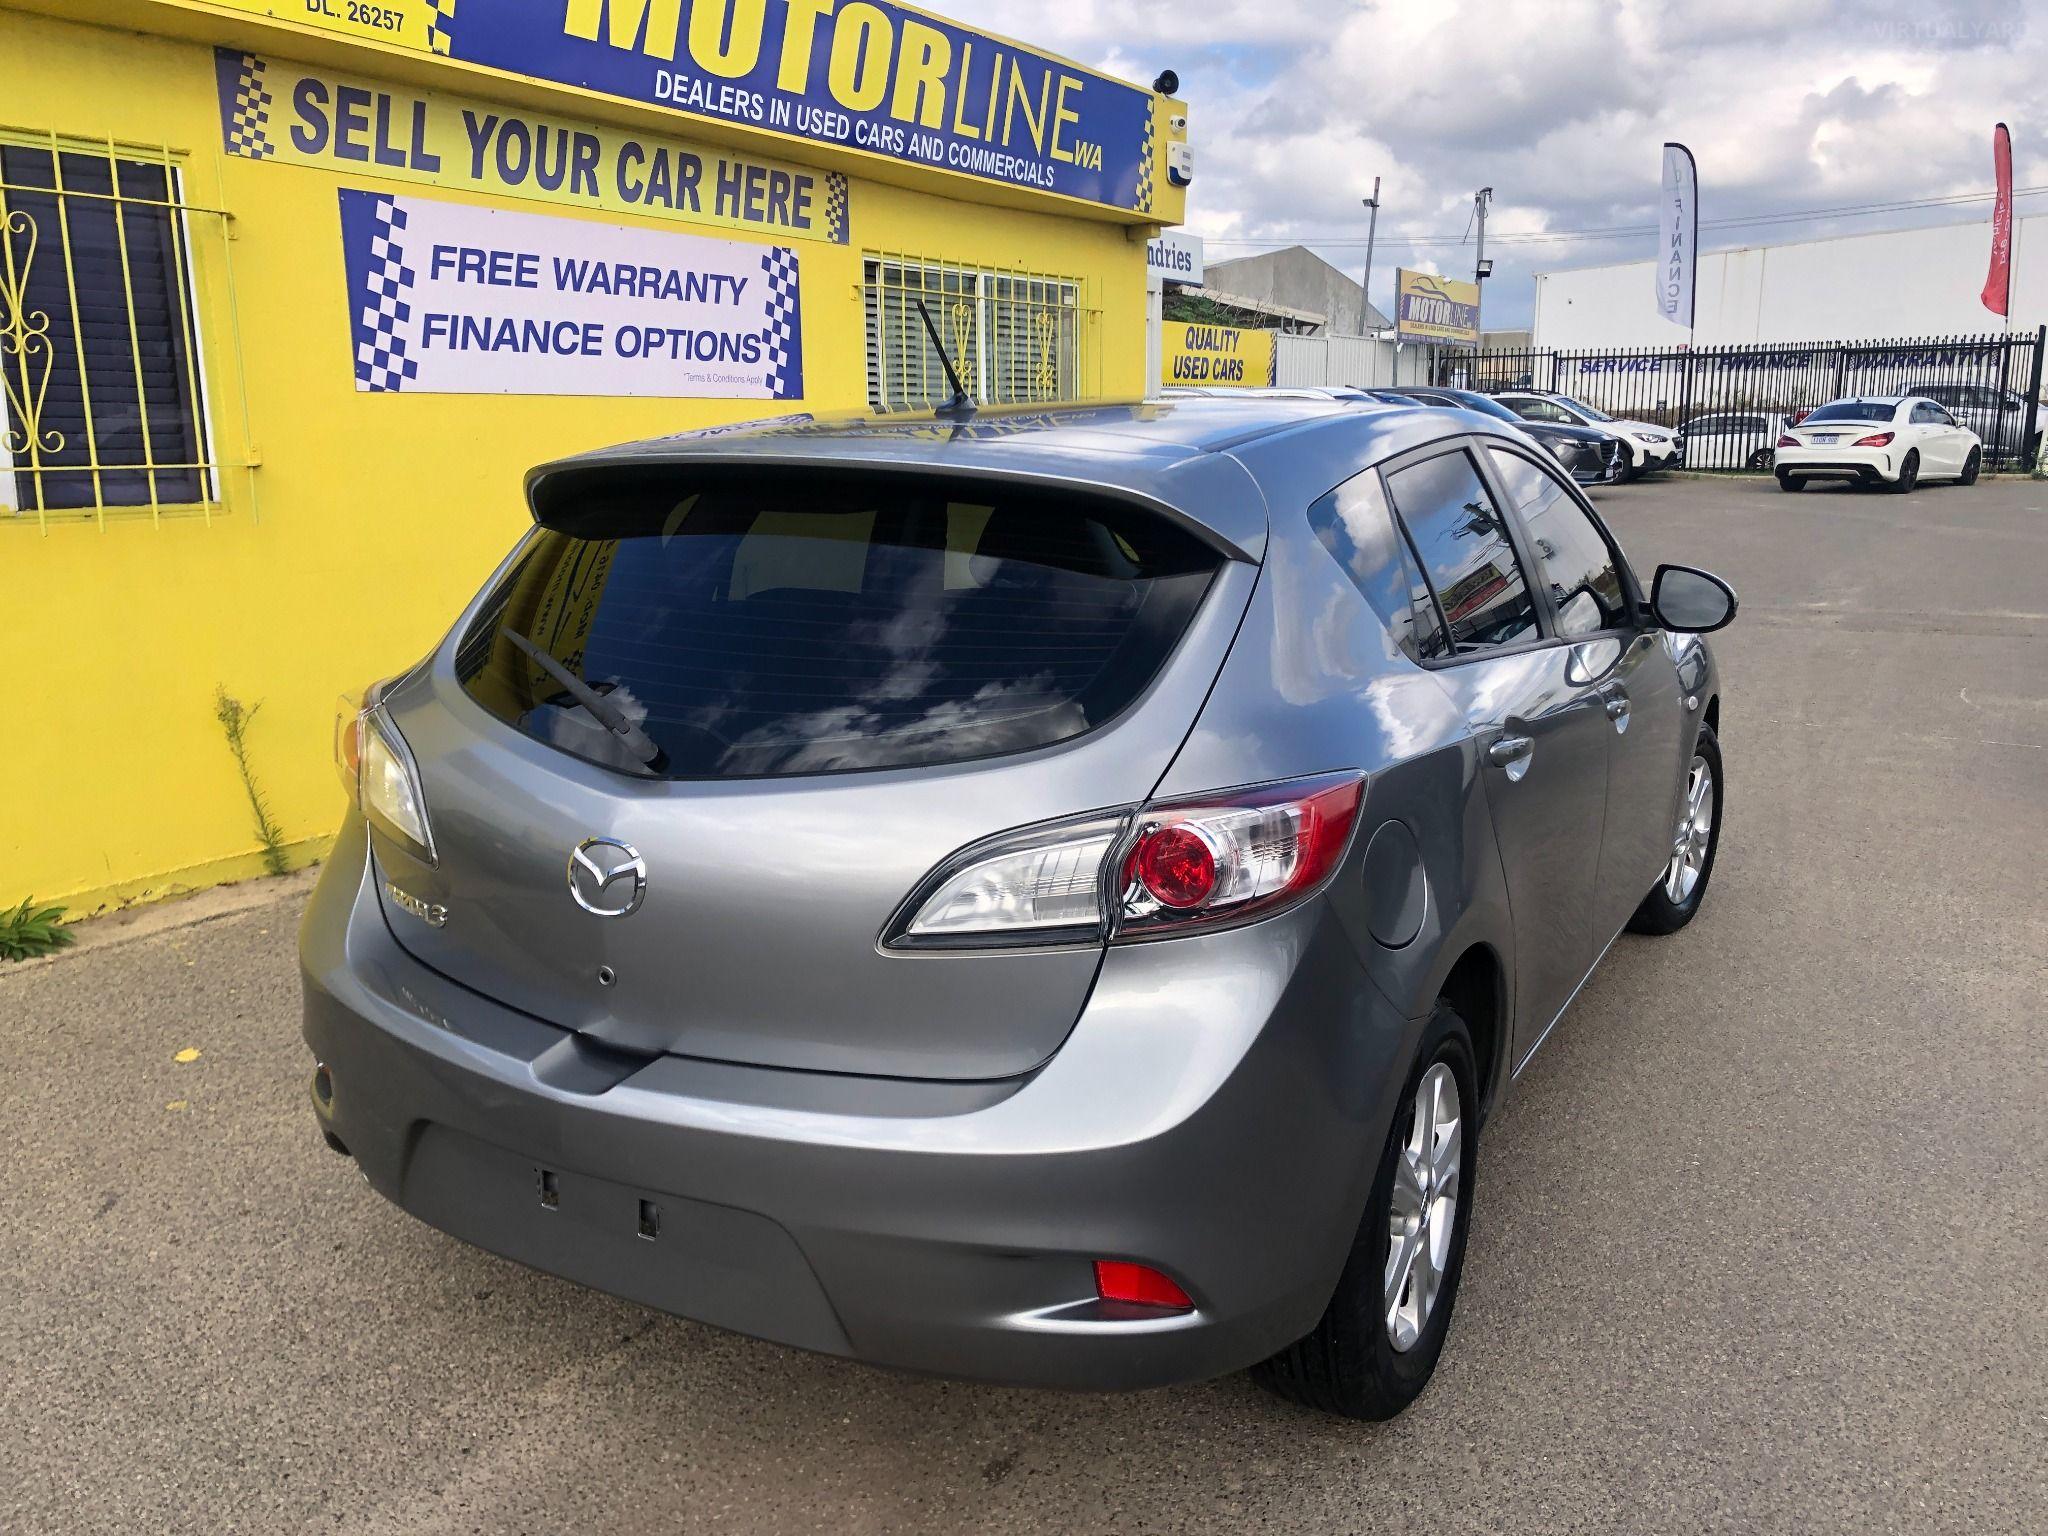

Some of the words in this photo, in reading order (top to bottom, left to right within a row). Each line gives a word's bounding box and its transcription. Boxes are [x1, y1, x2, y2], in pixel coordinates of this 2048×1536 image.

[348, 1, 404, 32] 26257
[655, 70, 763, 121] DEALERS
[770, 98, 790, 127] IN
[797, 105, 849, 140] USED
[855, 119, 905, 153] CARS
[908, 132, 943, 161] AND
[949, 142, 1054, 187] COMMERCIALS
[290, 77, 441, 174] SELL
[462, 110, 601, 198] YOUR
[617, 141, 702, 212] CAR
[715, 159, 814, 229] HERE
[1075, 140, 1102, 172] WA
[430, 245, 540, 289] FREE
[553, 257, 748, 306] WARRANTY
[1409, 296, 1469, 328] MOTORLINE
[422, 313, 604, 356] FINANCE
[615, 325, 761, 364] OPTIONS
[1186, 326, 1240, 352] QUALITY
[706, 373, 711, 382] &
[712, 373, 745, 383] Conditions
[746, 375, 763, 386] Apply
[1173, 355, 1209, 380] USED
[1212, 357, 1244, 381] CARS
[1579, 358, 1662, 373] SERVICE
